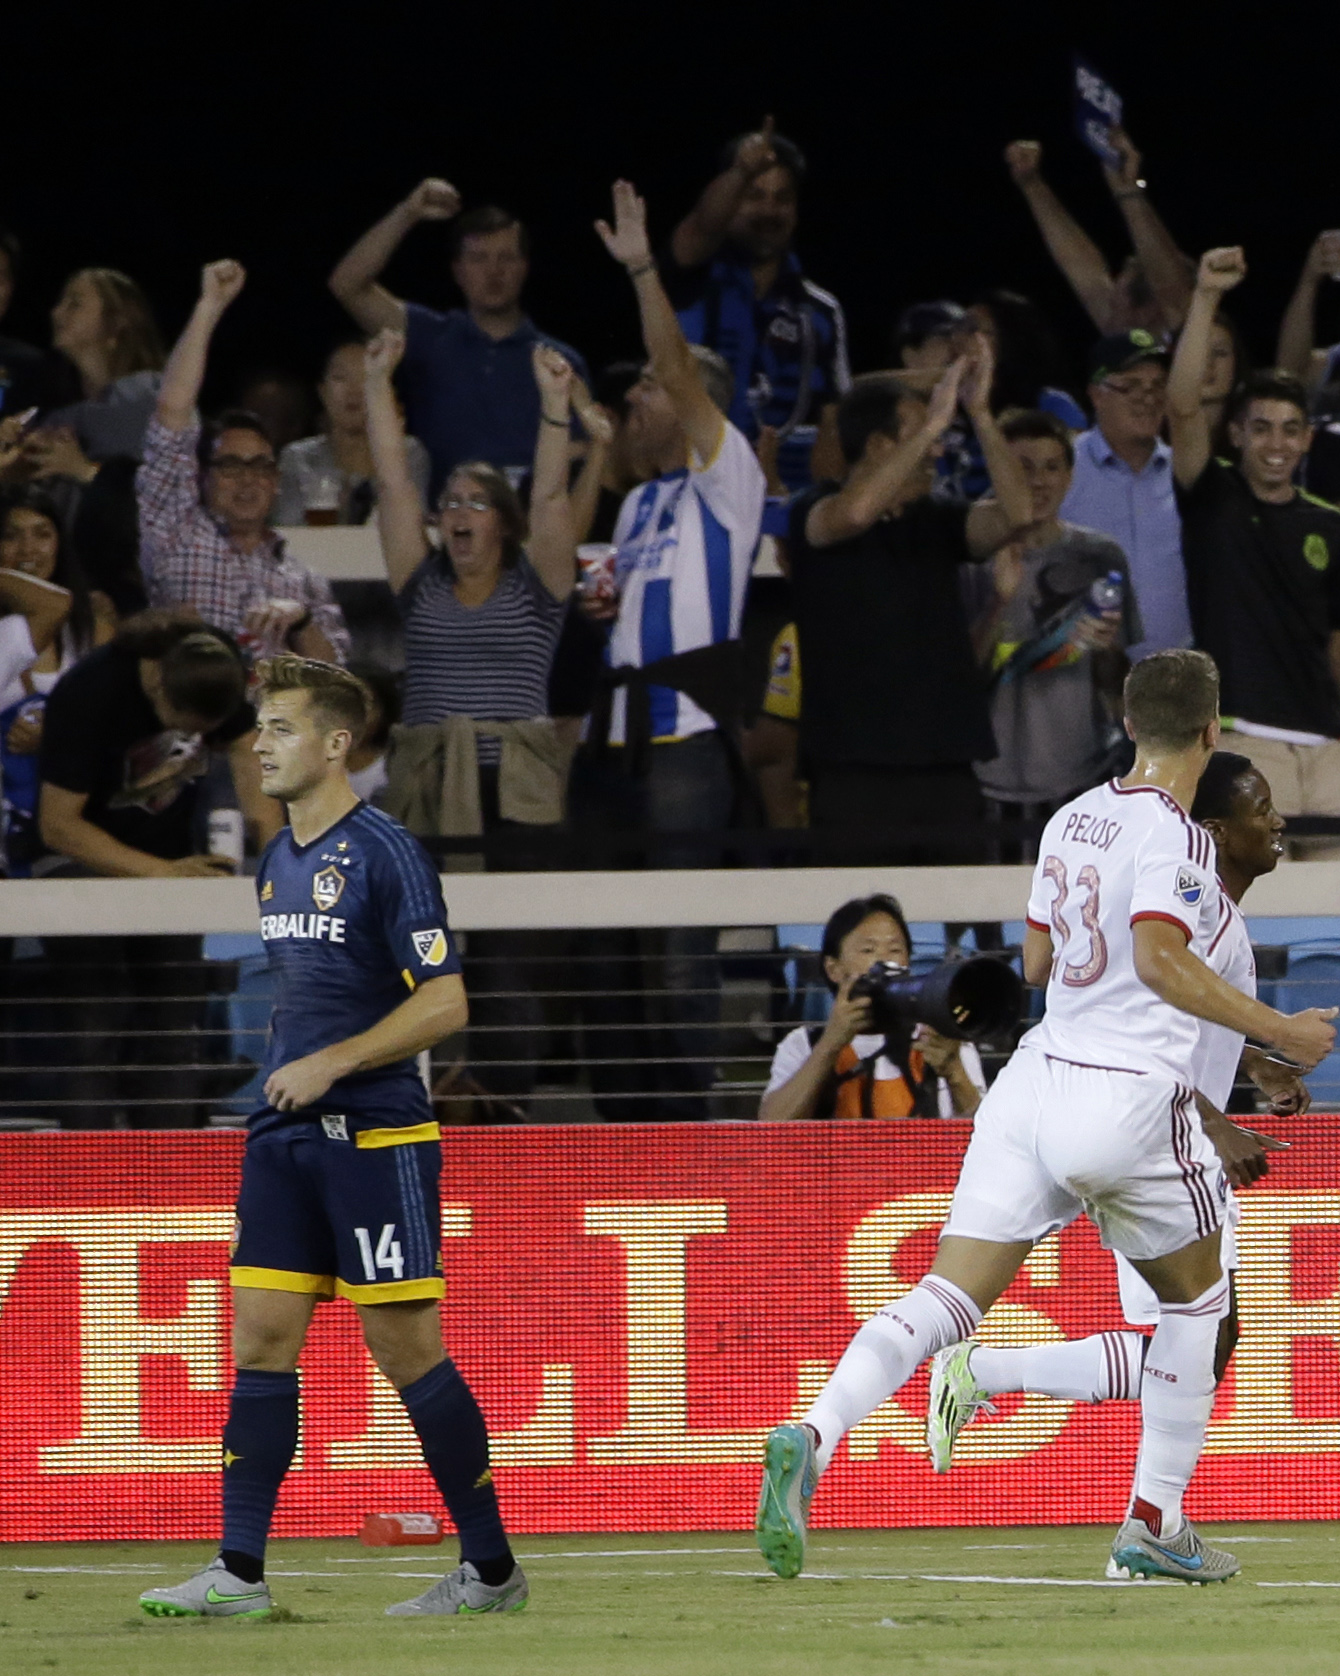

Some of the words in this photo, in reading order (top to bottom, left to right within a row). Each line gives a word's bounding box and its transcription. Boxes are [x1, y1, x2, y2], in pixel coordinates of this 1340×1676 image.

[1061, 813, 1122, 852] PELOSI
[261, 913, 346, 943] ERBALIFE
[1042, 855, 1108, 987] 33
[354, 1223, 405, 1281] 14
[0, 1192, 1074, 1474] ELLS
